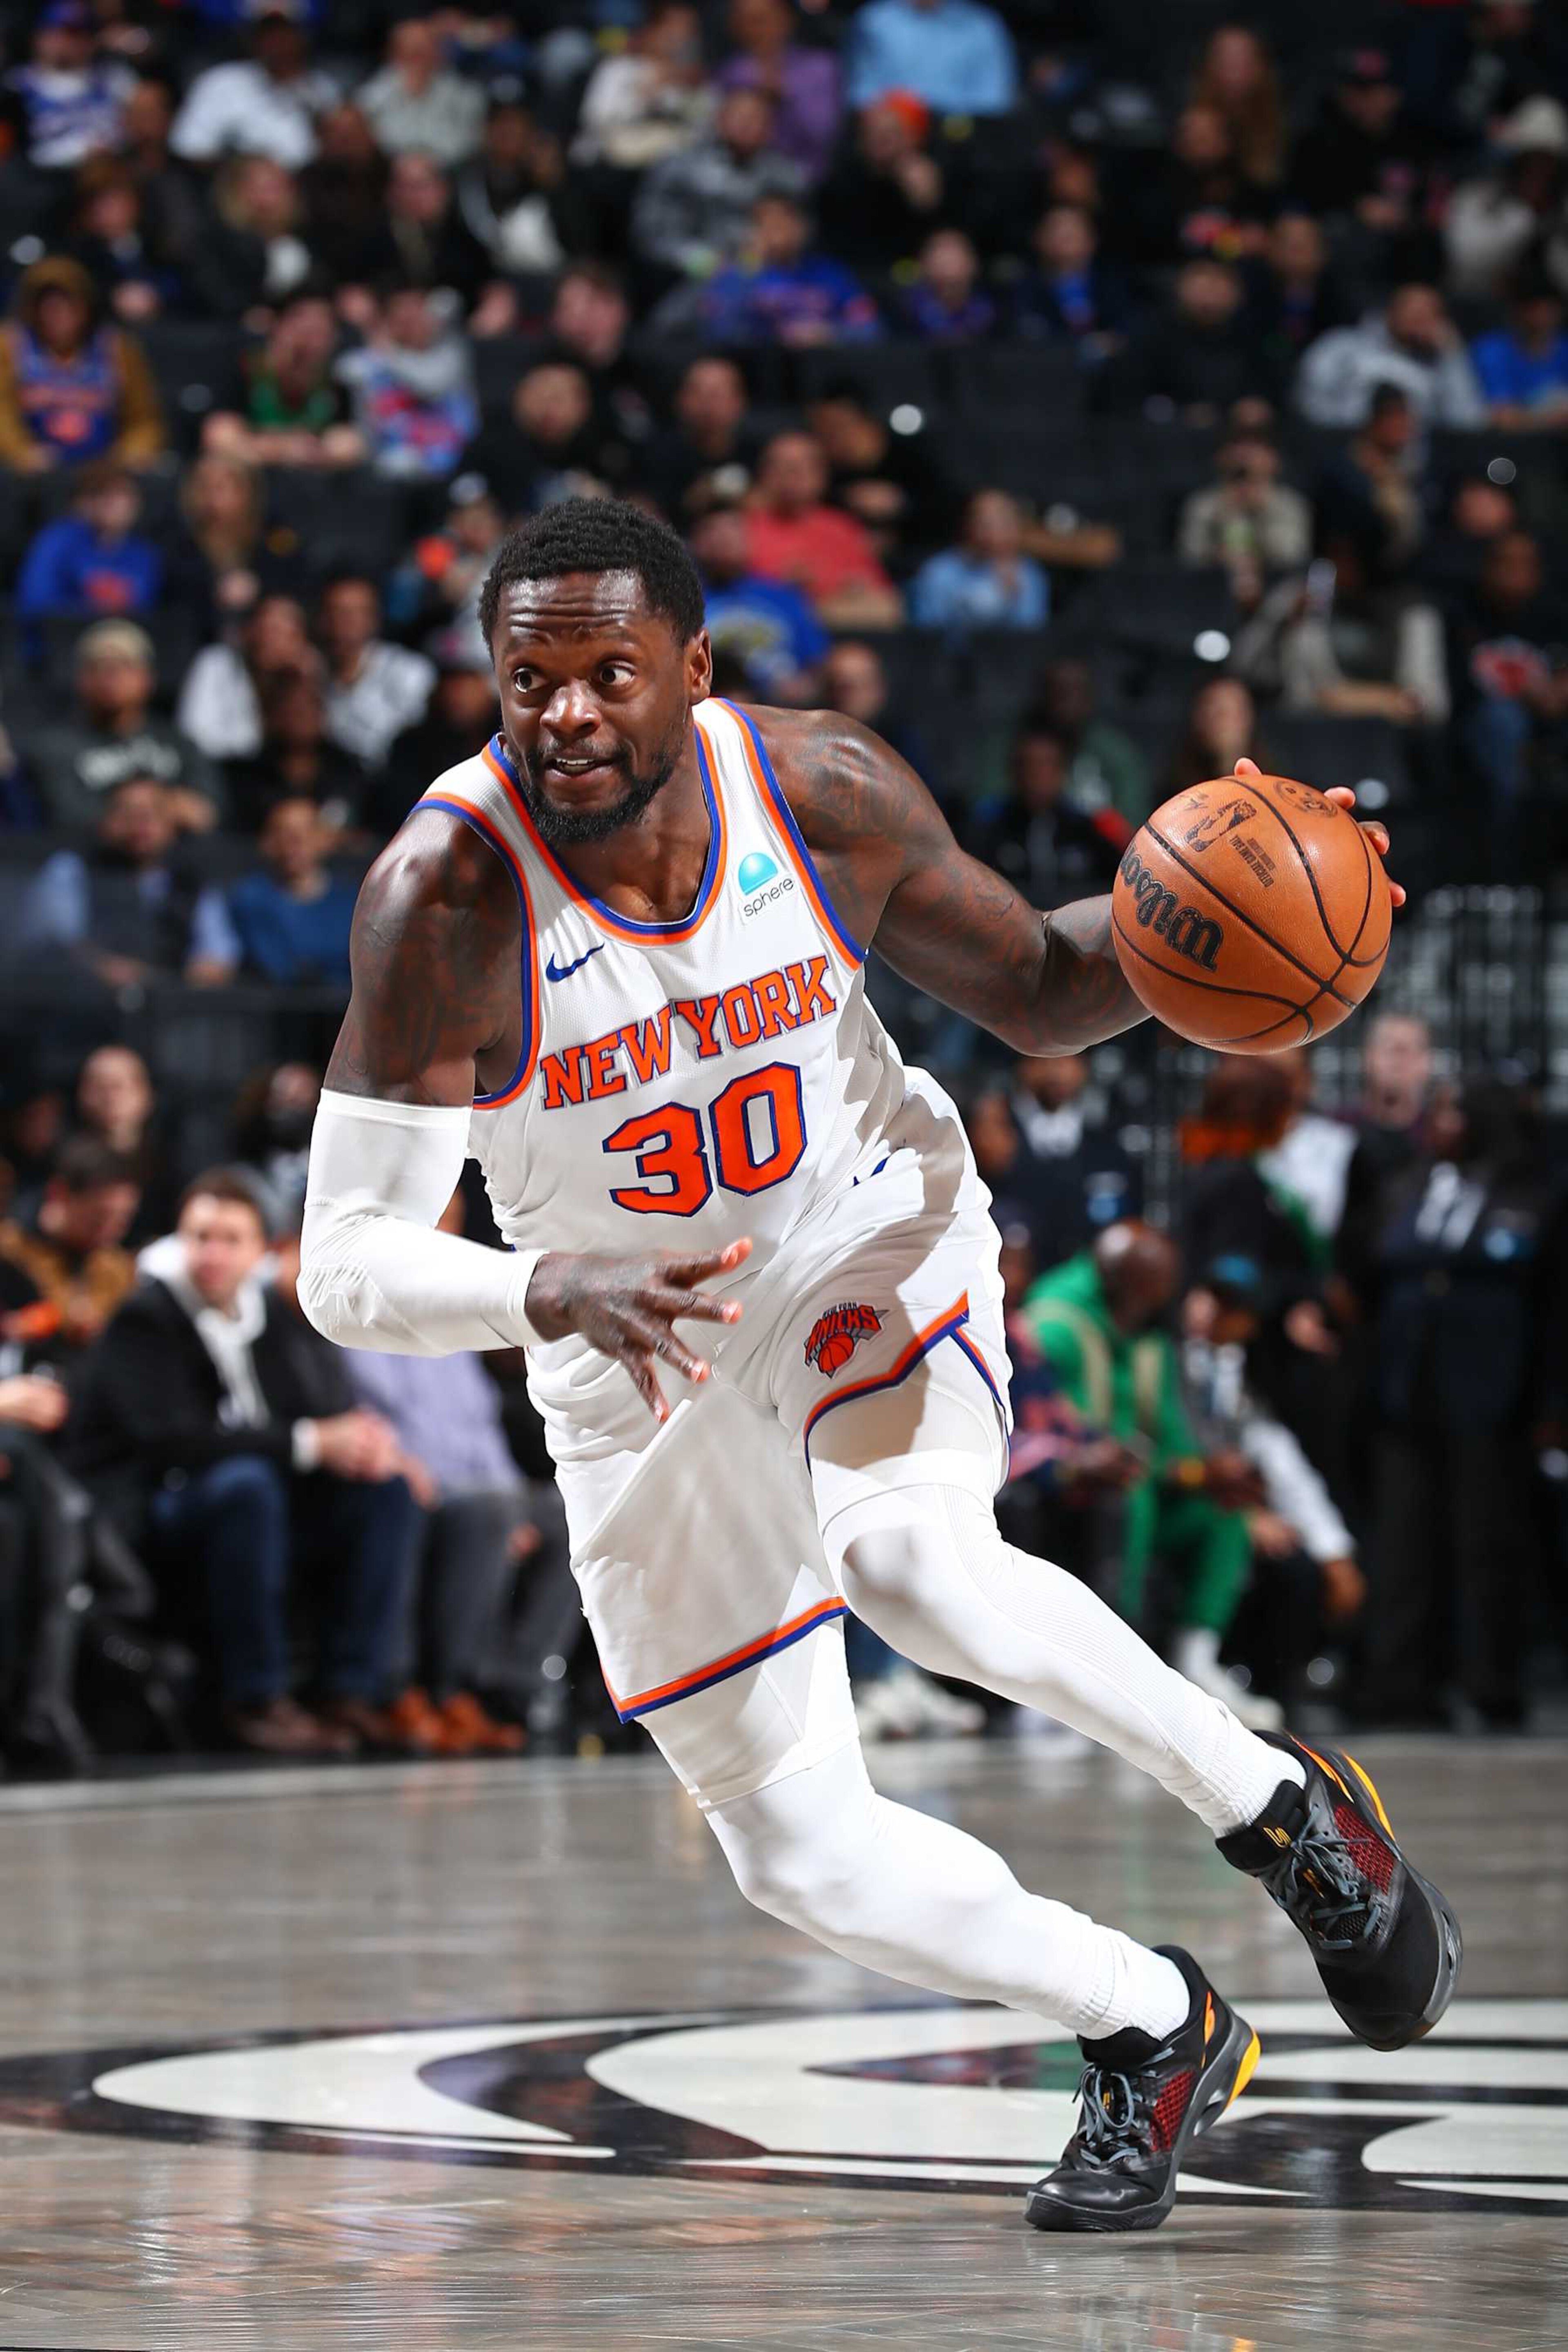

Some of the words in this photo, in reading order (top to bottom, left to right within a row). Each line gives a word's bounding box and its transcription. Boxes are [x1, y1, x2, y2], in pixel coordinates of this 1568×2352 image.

[744, 878, 793, 917] sphere
[539, 1002, 673, 1110] NEW
[671, 955, 837, 1060] YORK
[602, 1061, 808, 1217] 30
[804, 1304, 882, 1367] KNICKS
